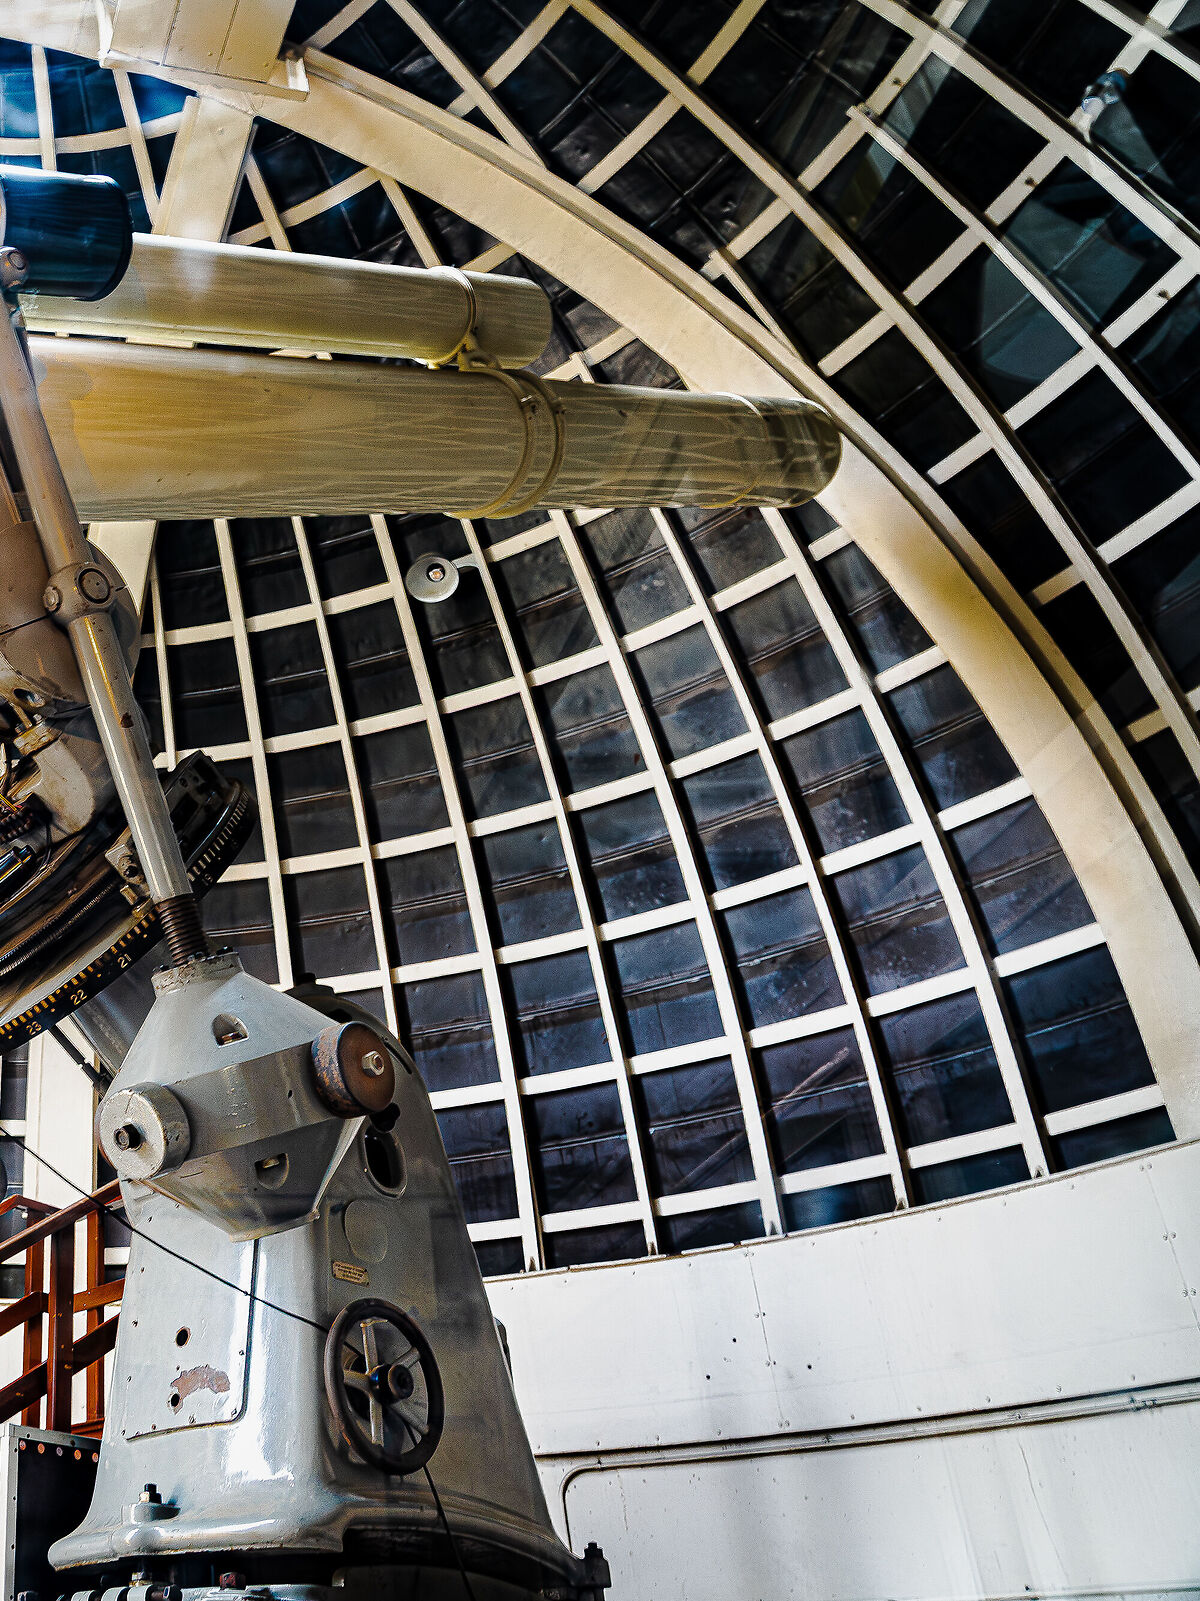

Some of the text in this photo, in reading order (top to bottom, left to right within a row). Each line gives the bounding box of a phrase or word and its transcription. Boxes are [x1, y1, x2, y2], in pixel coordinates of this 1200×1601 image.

[116, 953, 133, 969] 21
[69, 989, 88, 1006] 22
[25, 1020, 43, 1036] 23
